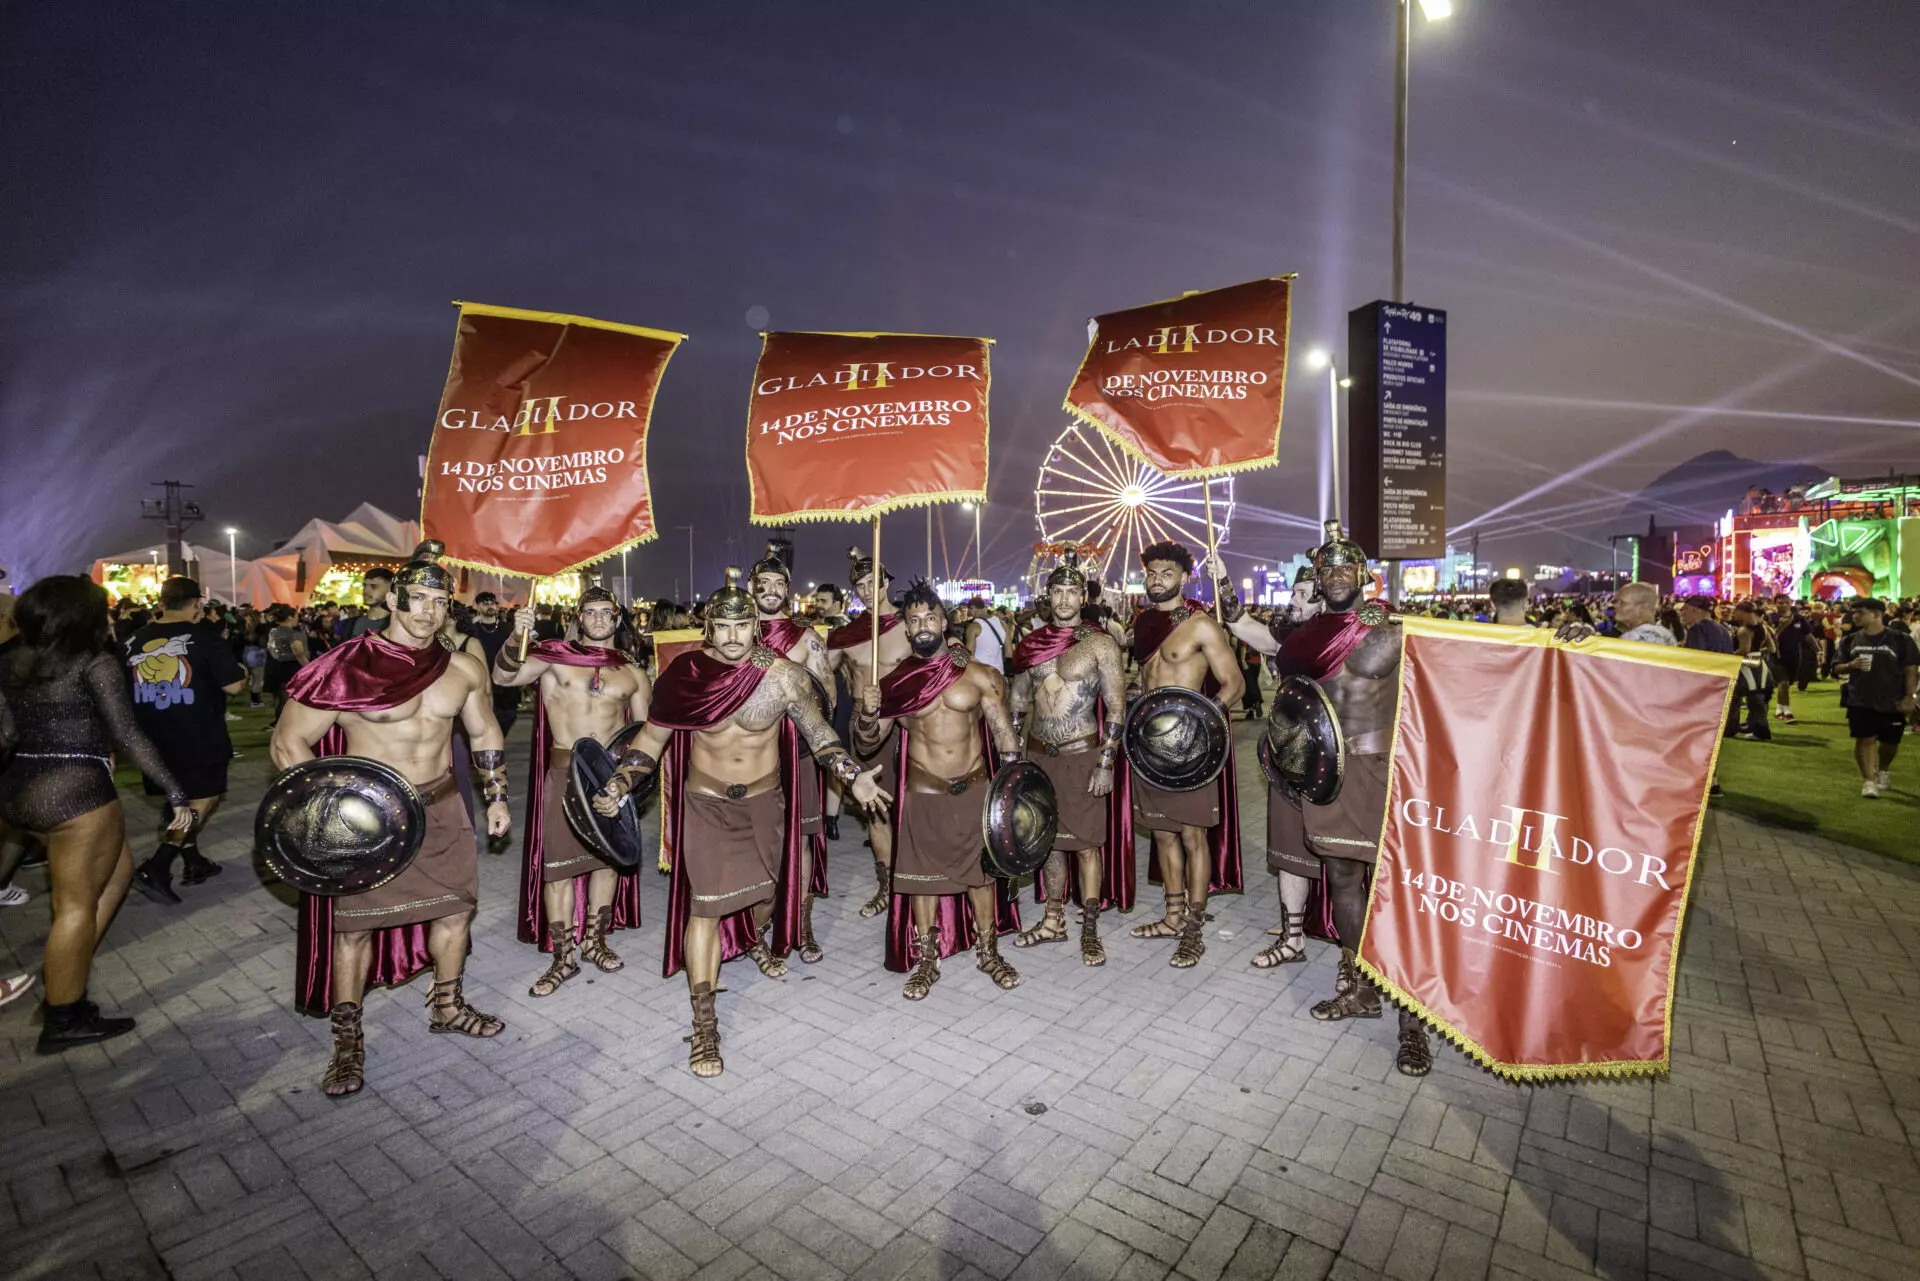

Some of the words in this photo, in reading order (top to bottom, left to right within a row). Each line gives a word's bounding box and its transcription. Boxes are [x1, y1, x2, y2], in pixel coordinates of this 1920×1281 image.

[1101, 327, 1280, 354] LADIADOR
[1152, 323, 1203, 354] II
[758, 364, 981, 396] GLADIADOR
[837, 361, 897, 392] II
[1102, 388, 1144, 398] NOS
[1147, 384, 1248, 401] CINEMAS
[1105, 375, 1136, 389] DE
[1139, 369, 1267, 389] NOVEMBRO
[441, 401, 640, 433] GLADIADOR
[512, 396, 568, 436] II
[760, 419, 781, 436] 14
[784, 411, 819, 429] DE
[823, 400, 972, 421] NOVEMBRO
[776, 421, 827, 446] NOS
[832, 413, 951, 432] CINEMAS
[441, 462, 462, 475] 14
[466, 461, 498, 478] DE
[497, 448, 625, 475] NOVEMBRO
[457, 476, 504, 493] NOS
[508, 467, 608, 491] CINEMAS
[1402, 799, 1672, 891] GLADIADOR
[1494, 804, 1568, 875] II
[1401, 868, 1425, 889] 14
[1427, 874, 1467, 902] DE
[1470, 887, 1643, 950] NOVEMBRO
[1418, 894, 1477, 928] NOS
[1482, 913, 1612, 968] CINEMAS
